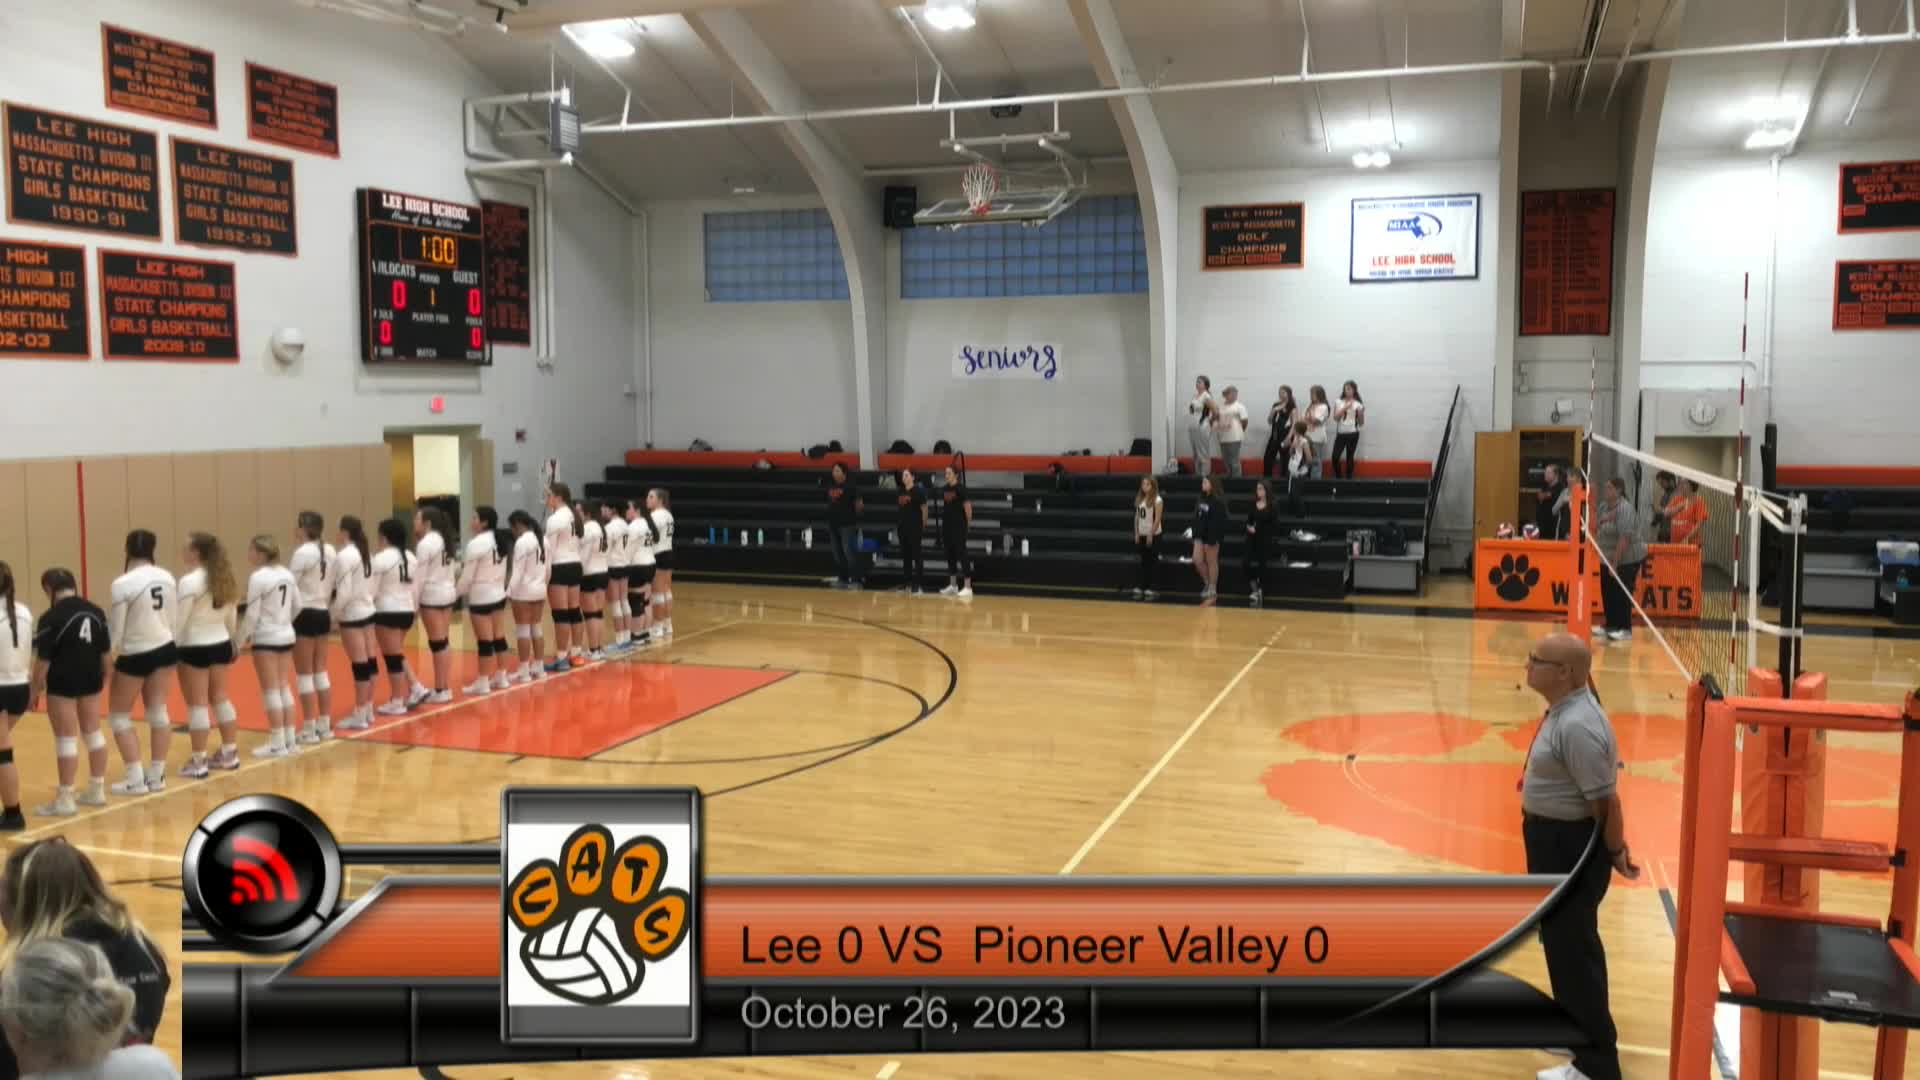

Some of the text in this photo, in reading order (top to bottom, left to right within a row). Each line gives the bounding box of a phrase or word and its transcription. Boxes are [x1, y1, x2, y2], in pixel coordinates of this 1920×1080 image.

[36, 116, 131, 147] LEE HIGH
[13, 131, 95, 162] MASSACHUSETTS
[18, 155, 151, 191] STATE CHAMPIONS
[196, 148, 273, 174] LEE HIGH
[24, 177, 149, 212] GIRLS BASKETBALL
[184, 184, 289, 213] STATE CHAMPIONS
[382, 192, 470, 222] LEE HIGH SCHOOL
[186, 203, 217, 222] GIRLS
[6, 248, 48, 264] HIGH
[421, 235, 456, 264] 1:00
[1220, 243, 1287, 255] CHAMPIONS
[1372, 253, 1456, 266] LEE HIGH SCHOOL
[136, 259, 166, 275] LEE
[372, 260, 416, 278] WILDCATS
[453, 270, 478, 285] GUEST
[0, 288, 71, 309] HAMPIONS
[392, 279, 407, 310] 0
[468, 288, 481, 316] 0
[114, 297, 227, 318] STATE CHAMPIONS
[111, 317, 231, 337] GIRLS BASKETBALL
[380, 320, 392, 345] 0
[471, 327, 482, 349] 0
[150, 586, 164, 611] 5
[278, 584, 288, 606] 7
[79, 617, 92, 643] 4
